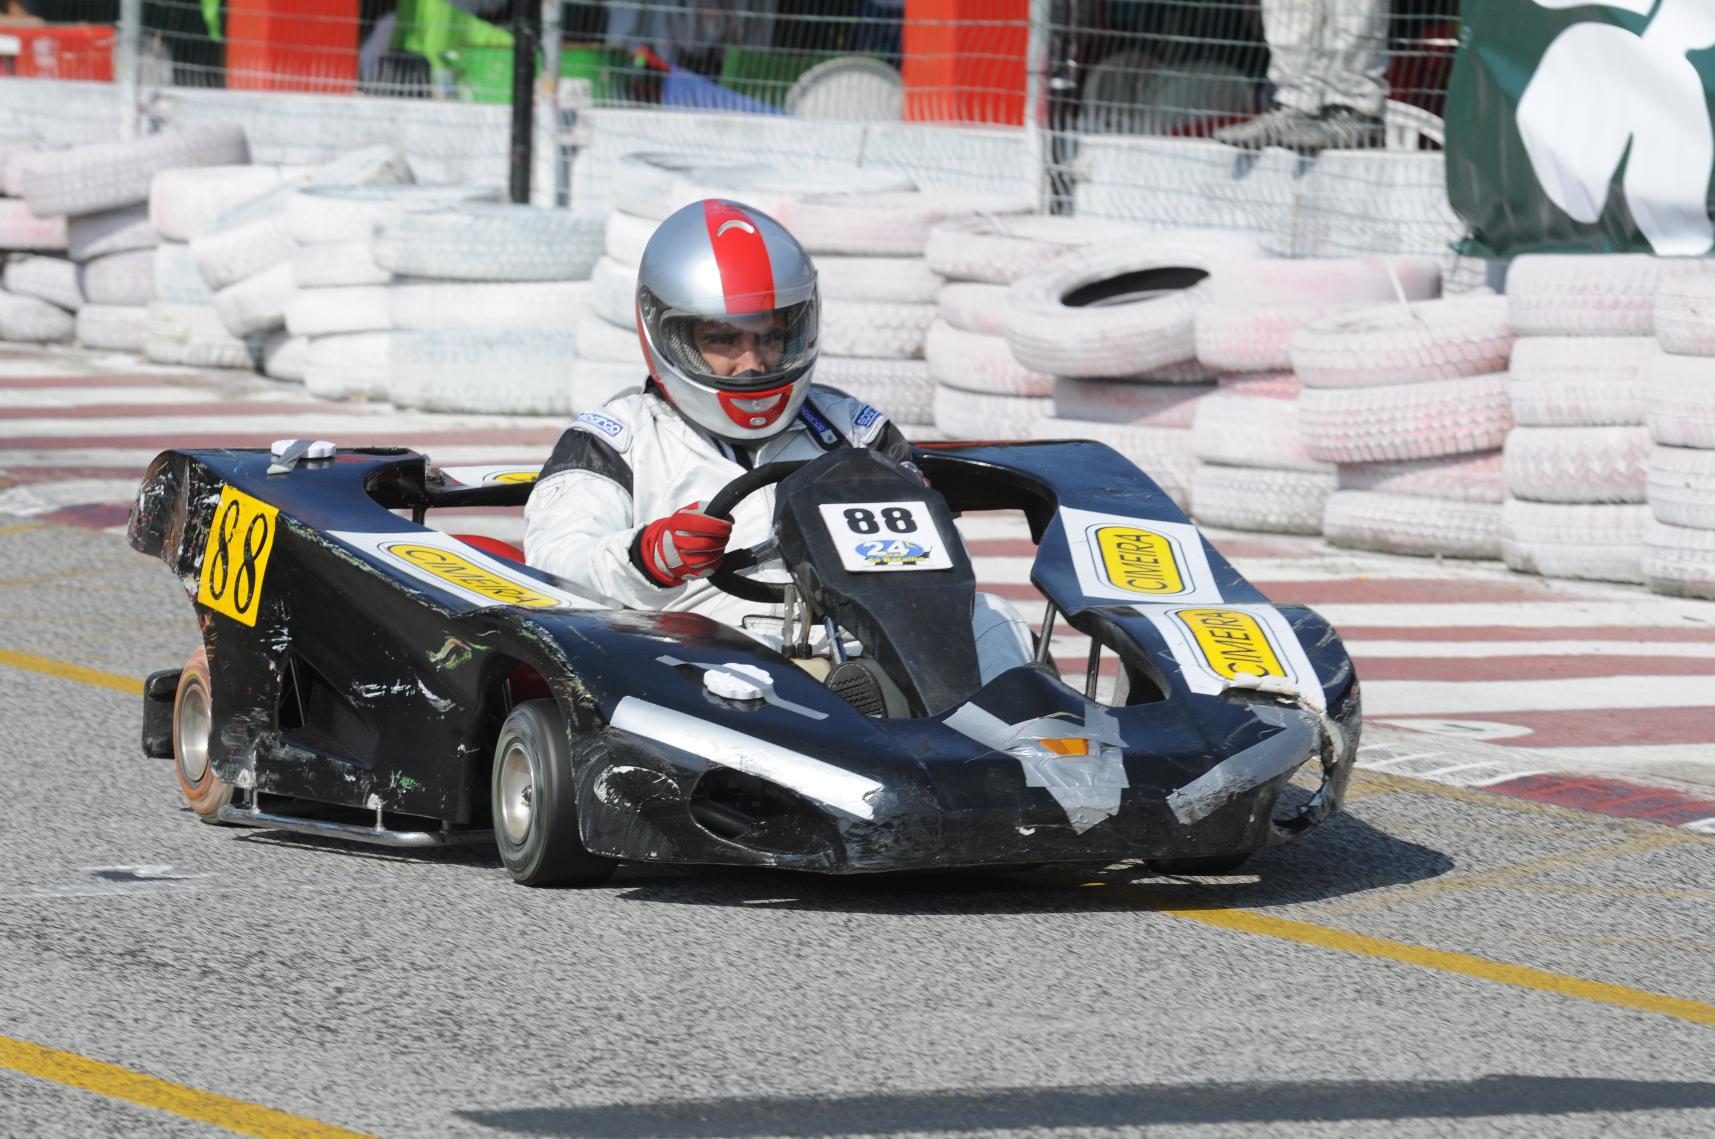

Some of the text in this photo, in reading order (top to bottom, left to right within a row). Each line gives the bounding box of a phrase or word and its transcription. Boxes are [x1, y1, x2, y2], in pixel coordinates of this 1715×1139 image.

[843, 507, 918, 534] 88
[209, 499, 268, 614] 88
[405, 550, 541, 604] CIMEIRA
[1114, 534, 1168, 590] CIMEIRA
[1195, 611, 1270, 677] CIMEIRA
